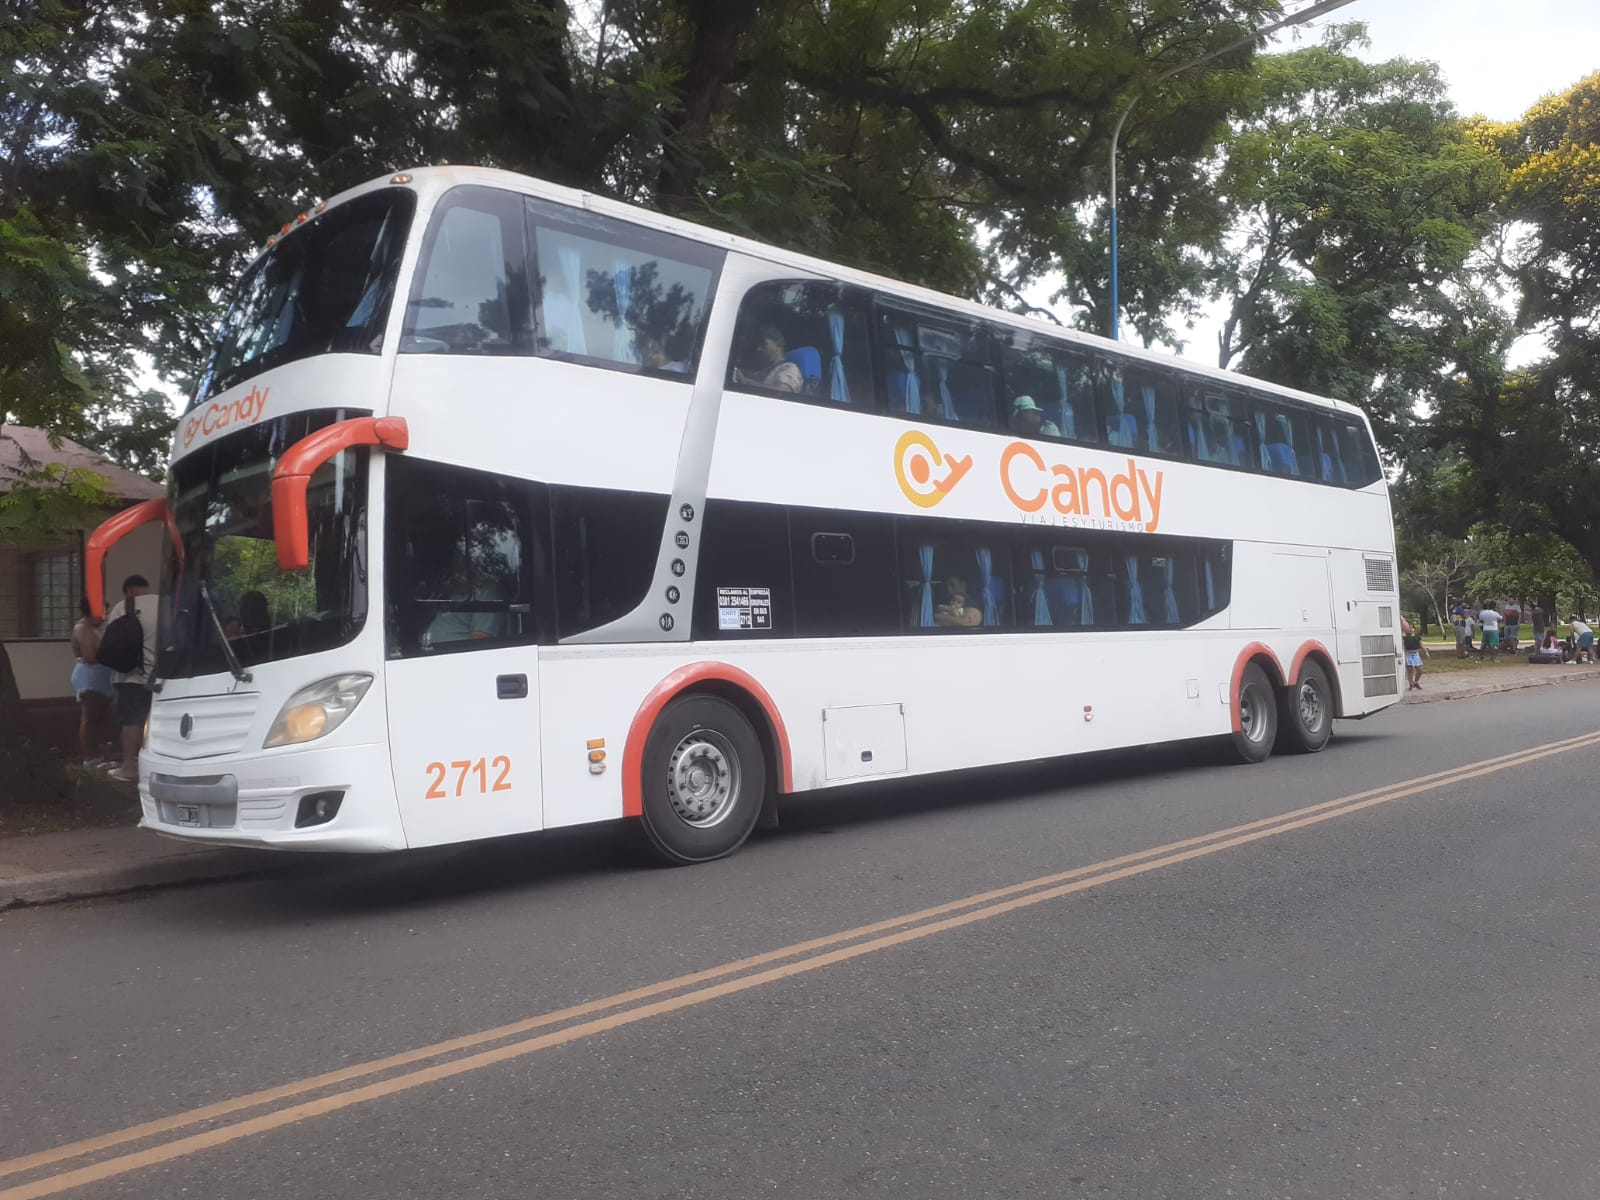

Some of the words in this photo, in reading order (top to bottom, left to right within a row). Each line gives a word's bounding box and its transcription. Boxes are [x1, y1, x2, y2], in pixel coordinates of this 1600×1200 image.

[202, 385, 270, 436] Candy
[1000, 442, 1163, 534] Candy
[425, 755, 512, 800] 2712
